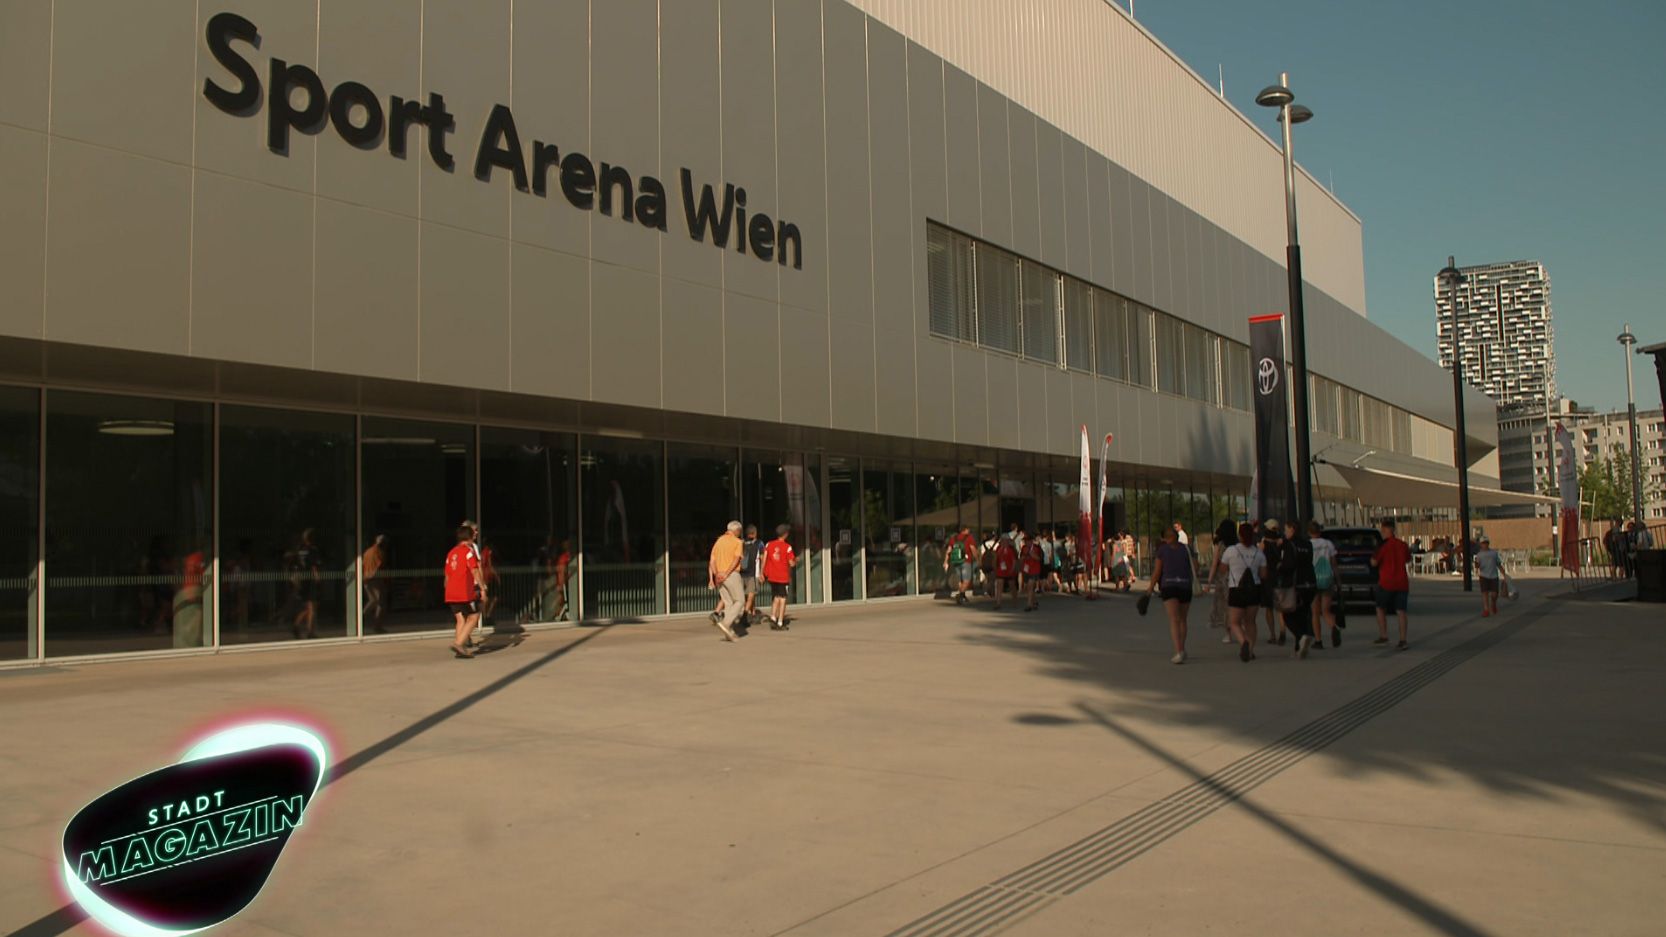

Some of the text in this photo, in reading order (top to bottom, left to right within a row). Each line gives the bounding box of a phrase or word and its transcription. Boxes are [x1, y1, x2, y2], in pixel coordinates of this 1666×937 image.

[203, 12, 803, 269] Sport Arena Wien
